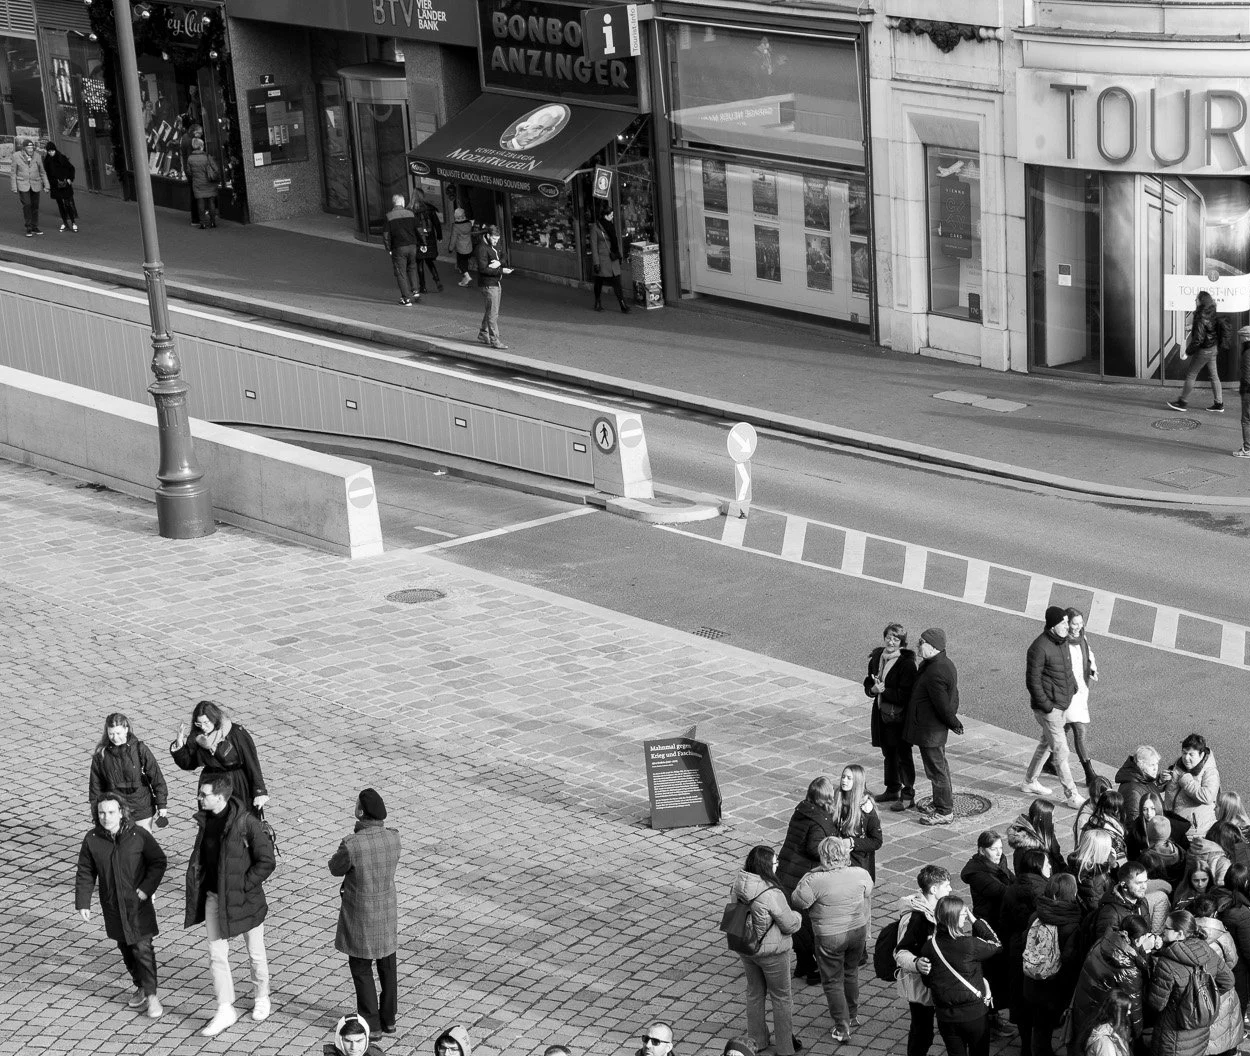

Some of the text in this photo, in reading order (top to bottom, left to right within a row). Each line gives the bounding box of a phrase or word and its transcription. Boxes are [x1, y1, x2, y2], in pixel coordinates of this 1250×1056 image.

[416, 0, 433, 9] VIER
[418, 20, 439, 31] BANK
[492, 11, 584, 48] BONBO
[630, 8, 640, 53] Tourist-Info
[491, 45, 630, 89] ANZINGER
[436, 167, 461, 179] EXQUISITE
[461, 171, 492, 184] CHOCOLATES
[492, 178, 503, 187] AND
[503, 179, 531, 192] SOUVENIRS
[650, 743, 676, 752] Mahnmal
[665, 750, 677, 758] und
